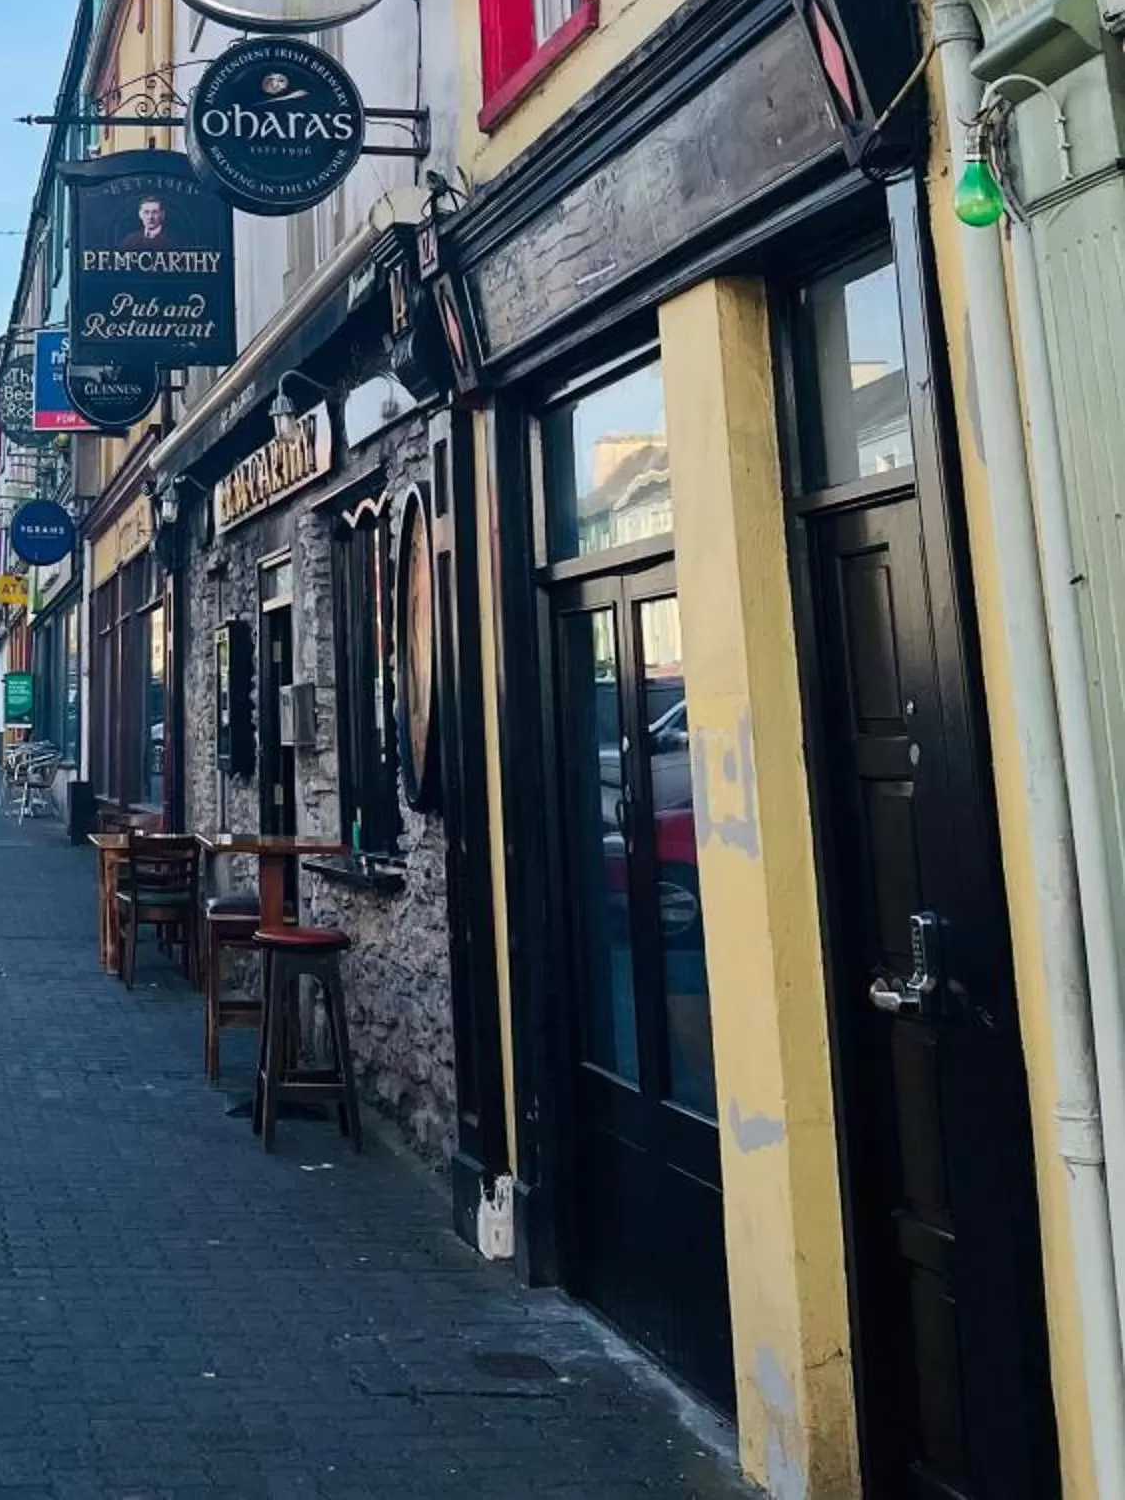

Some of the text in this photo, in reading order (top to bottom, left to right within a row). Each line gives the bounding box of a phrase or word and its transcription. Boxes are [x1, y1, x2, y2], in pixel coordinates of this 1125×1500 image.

[205, 48, 350, 108] INDEPENDENT IRISH BREWERY
[210, 145, 256, 190] BREWING
[260, 184, 274, 194] IN
[279, 185, 304, 195] THE
[110, 293, 206, 318] Pub and
[81, 312, 216, 339] Restaurant
